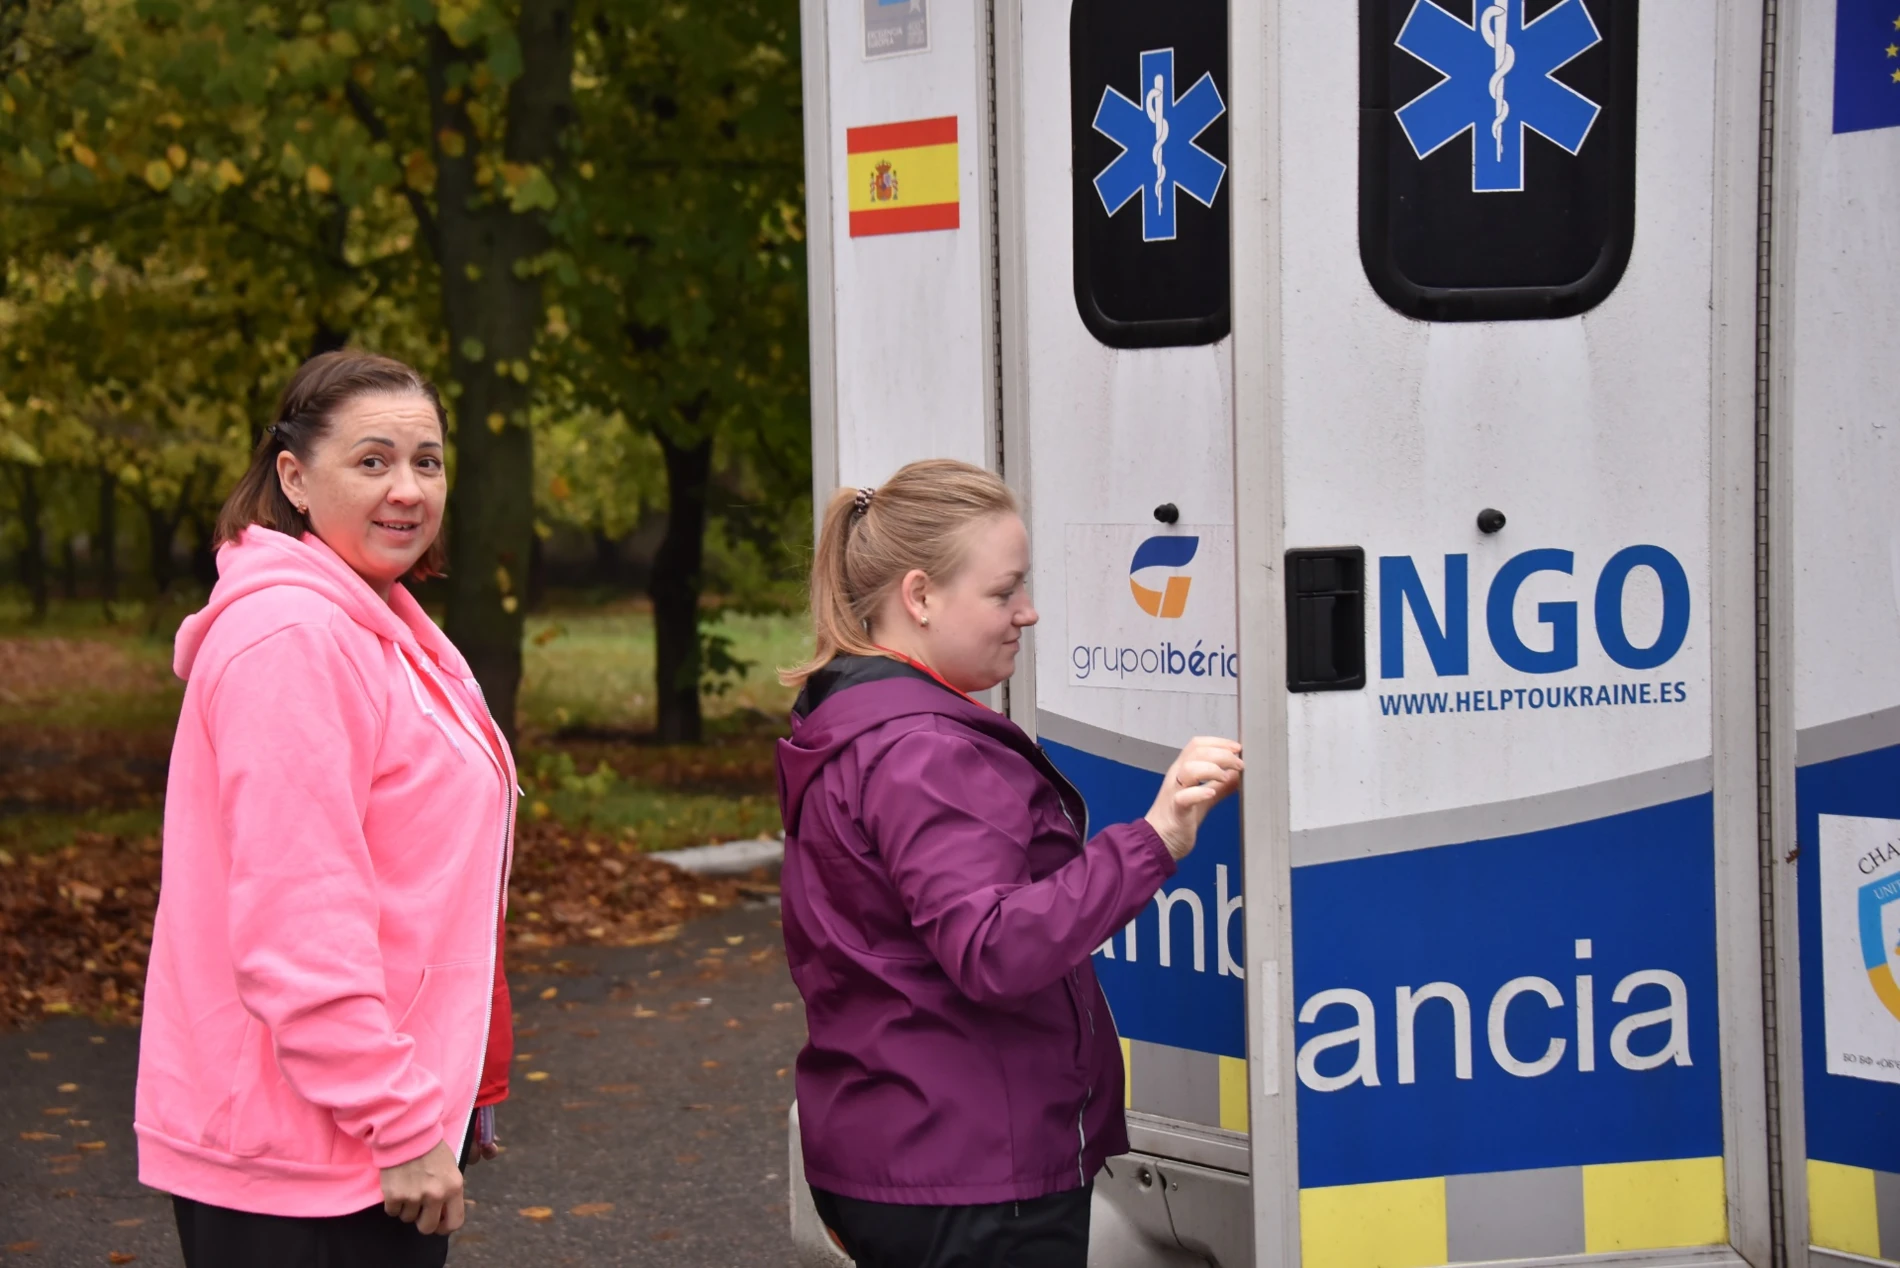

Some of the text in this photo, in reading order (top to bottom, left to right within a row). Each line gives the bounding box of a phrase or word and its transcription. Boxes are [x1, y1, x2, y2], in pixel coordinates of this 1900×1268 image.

[1379, 544, 1690, 679] NGO
[1379, 681, 1687, 716] WWW.HELPTOUKRAINE.ES
[1858, 837, 1900, 874] CHA
[1090, 863, 1244, 979] mb
[1296, 938, 1693, 1092] ancia
